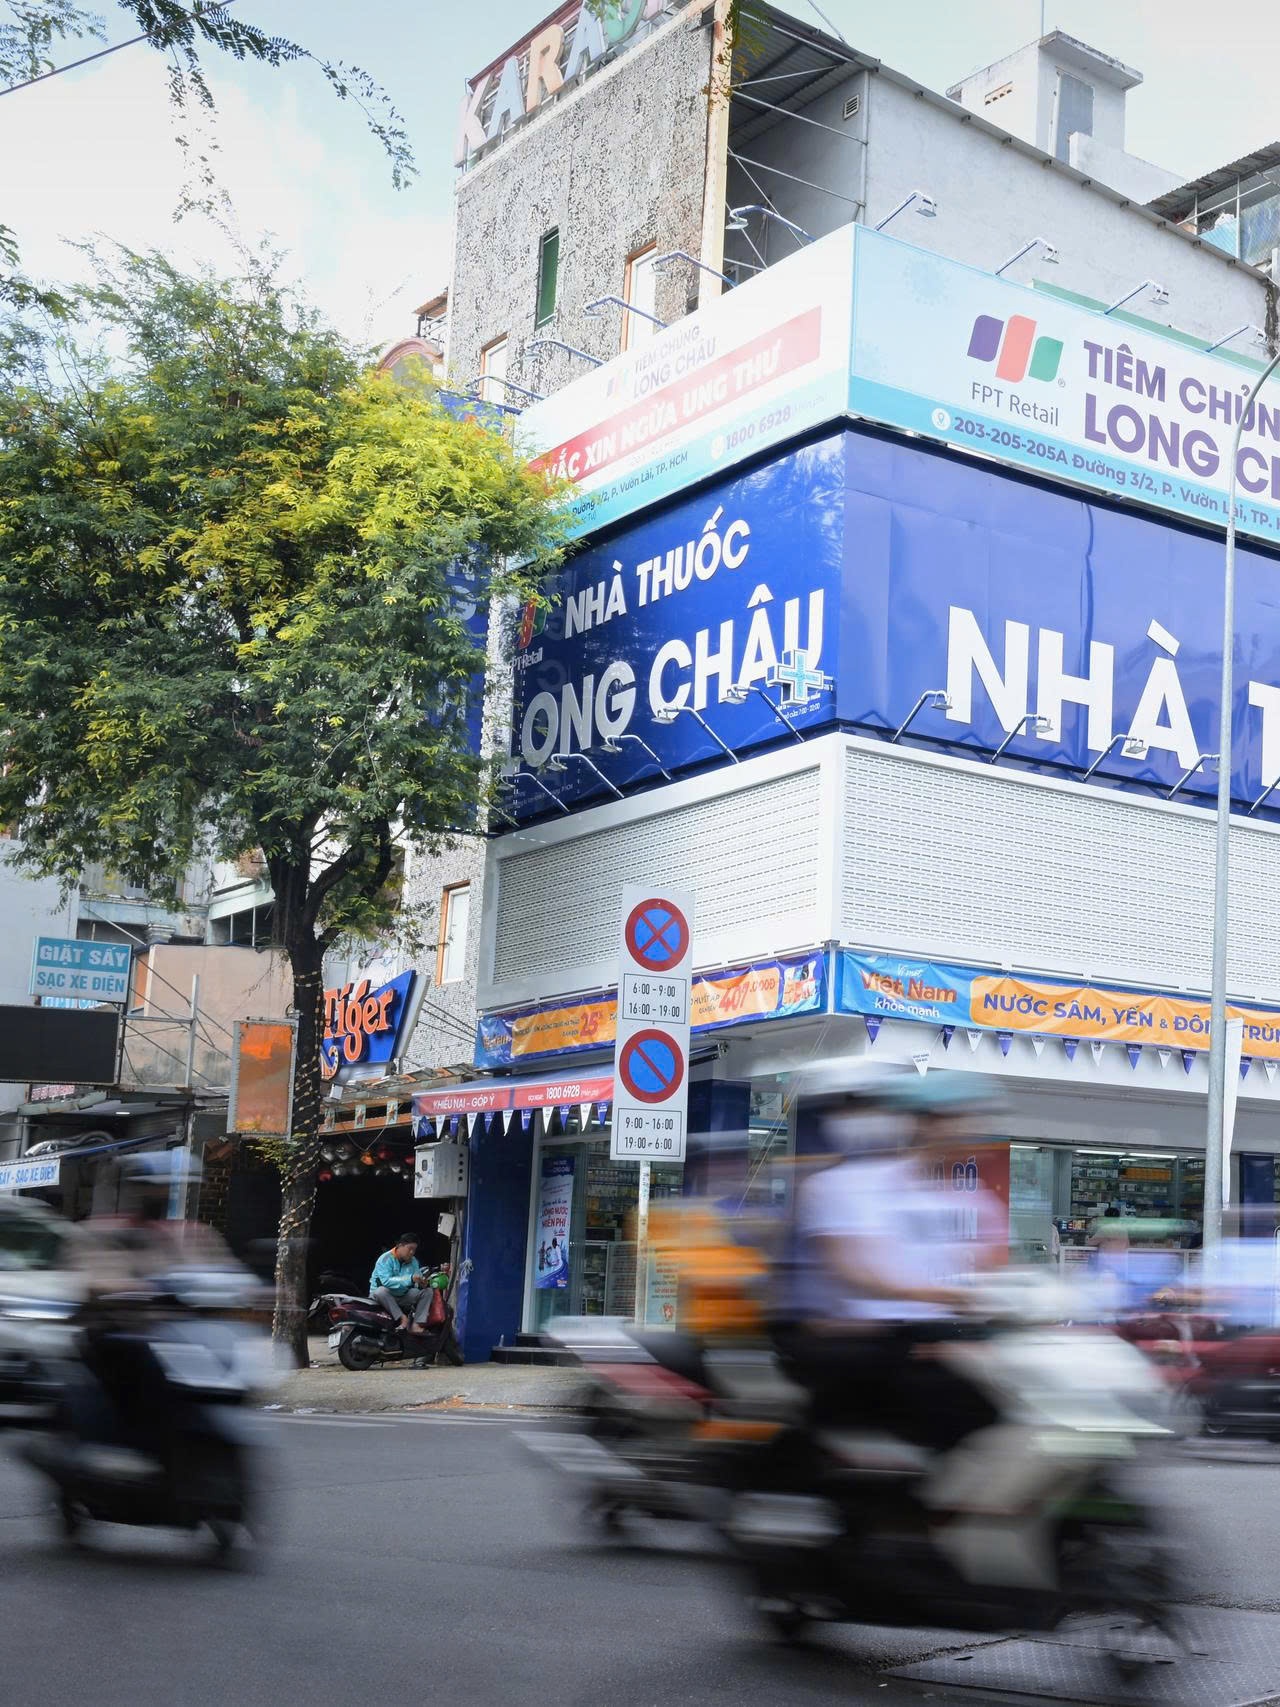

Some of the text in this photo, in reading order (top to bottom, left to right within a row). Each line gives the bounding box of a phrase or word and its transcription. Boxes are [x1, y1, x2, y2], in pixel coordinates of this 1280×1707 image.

[454, 0, 664, 167] KARAO
[1083, 340, 1167, 402] TIÊM
[971, 381, 1060, 427] FPT Retail
[725, 405, 792, 449] 1800 6928
[1085, 392, 1220, 478] LONG
[584, 433, 617, 469] XIN
[668, 450, 689, 469] HCM
[954, 416, 1068, 465] 203-205-205A
[1072, 453, 1126, 486] Đường
[1130, 471, 1158, 495] 3/2,
[1162, 482, 1176, 498] P.
[1180, 486, 1218, 512] Vườn
[1250, 508, 1272, 528] TP.
[564, 560, 627, 639] NHÀ
[636, 505, 751, 607] THUỐC
[650, 583, 824, 721] CHÂU
[945, 604, 1204, 774] NHÀ
[39, 944, 128, 968] GIẶT SẤY
[36, 971, 125, 995] SẠC XE ĐIỆN
[632, 982, 650, 995] 6:00
[658, 984, 676, 998] 9:00
[860, 968, 958, 1003] Việt Nam
[324, 979, 394, 1062] Tiger
[629, 1002, 650, 1015] 16:00
[659, 1005, 680, 1018] 19:00
[984, 991, 1047, 1016] NƯỚC
[1053, 999, 1107, 1026] SÂM,
[1111, 1004, 1152, 1028] YẾN
[1159, 1019, 1168, 1029] &
[472, 1094, 488, 1107] GÓP
[546, 1087, 561, 1099] 1800
[562, 1085, 580, 1098] 6928
[624, 1136, 647, 1149] 19:00
[655, 1137, 672, 1149] 6:00
[625, 1117, 643, 1130] 9:00
[652, 1118, 674, 1131] 16:00
[951, 1155, 978, 1193] CÓ
